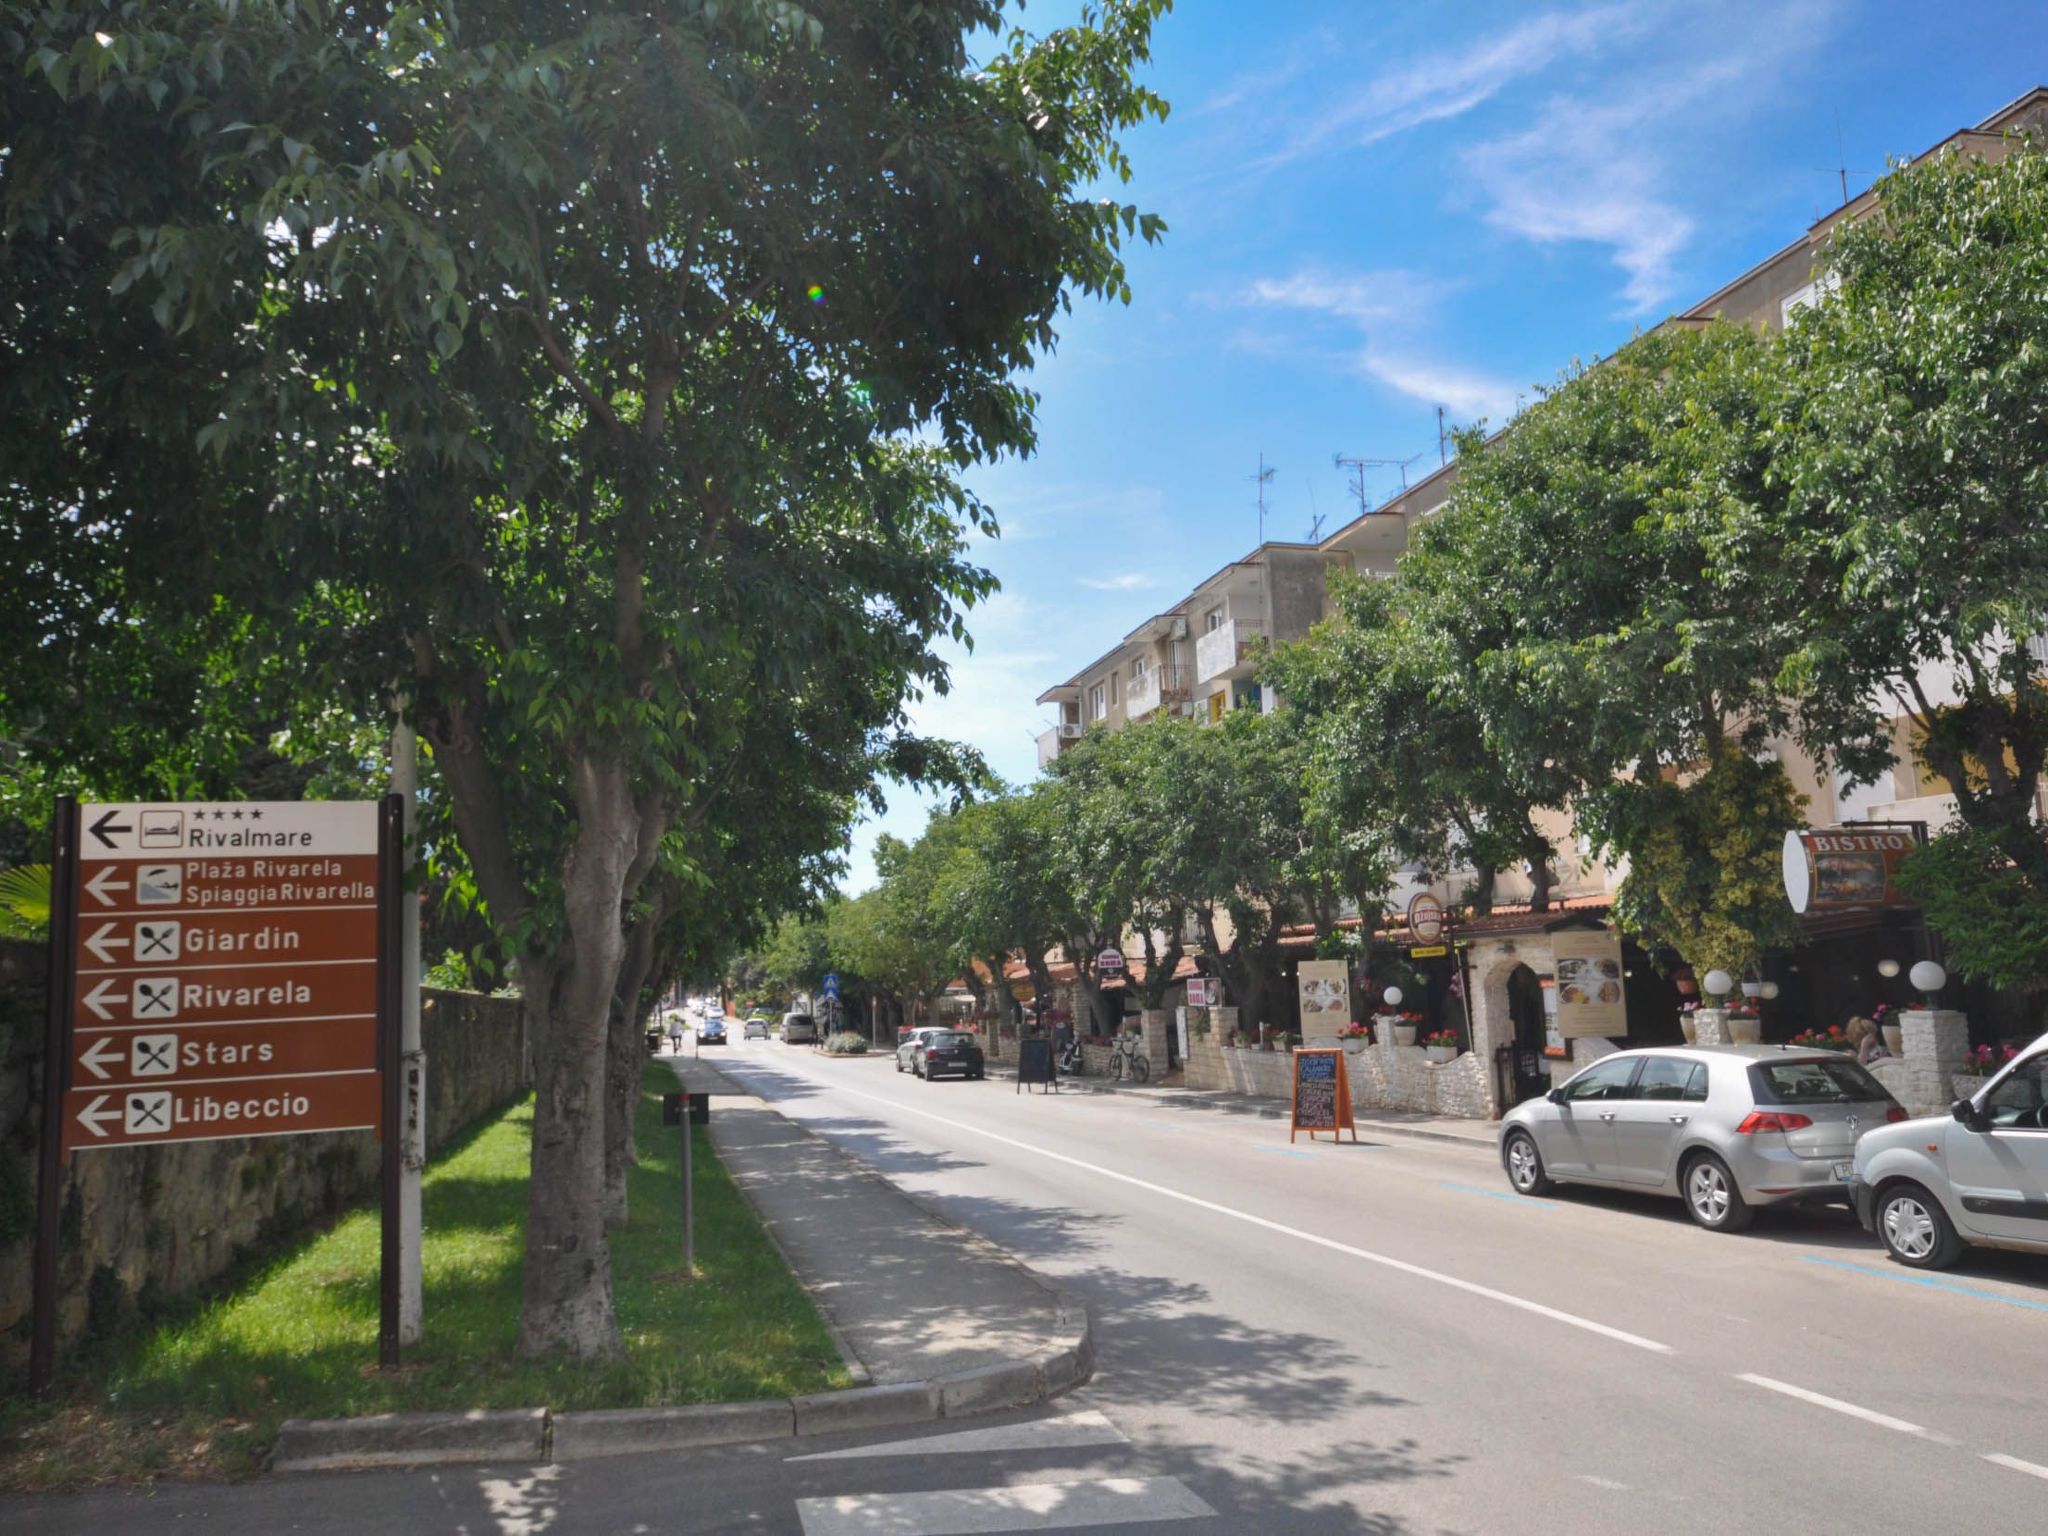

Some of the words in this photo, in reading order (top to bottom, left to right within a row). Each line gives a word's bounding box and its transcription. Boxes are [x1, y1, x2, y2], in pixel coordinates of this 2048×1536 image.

[189, 828, 312, 847] Rivalmare
[1813, 835, 1904, 852] BISTRO
[186, 862, 246, 879] Plaža
[253, 860, 342, 877] Rivarela
[186, 886, 277, 906] Spiaggia
[281, 882, 375, 900] Rivarella
[185, 926, 299, 952] Giardin
[183, 980, 311, 1009] Rivarela
[182, 1041, 274, 1066] Stars
[175, 1092, 309, 1123] Libeccio
